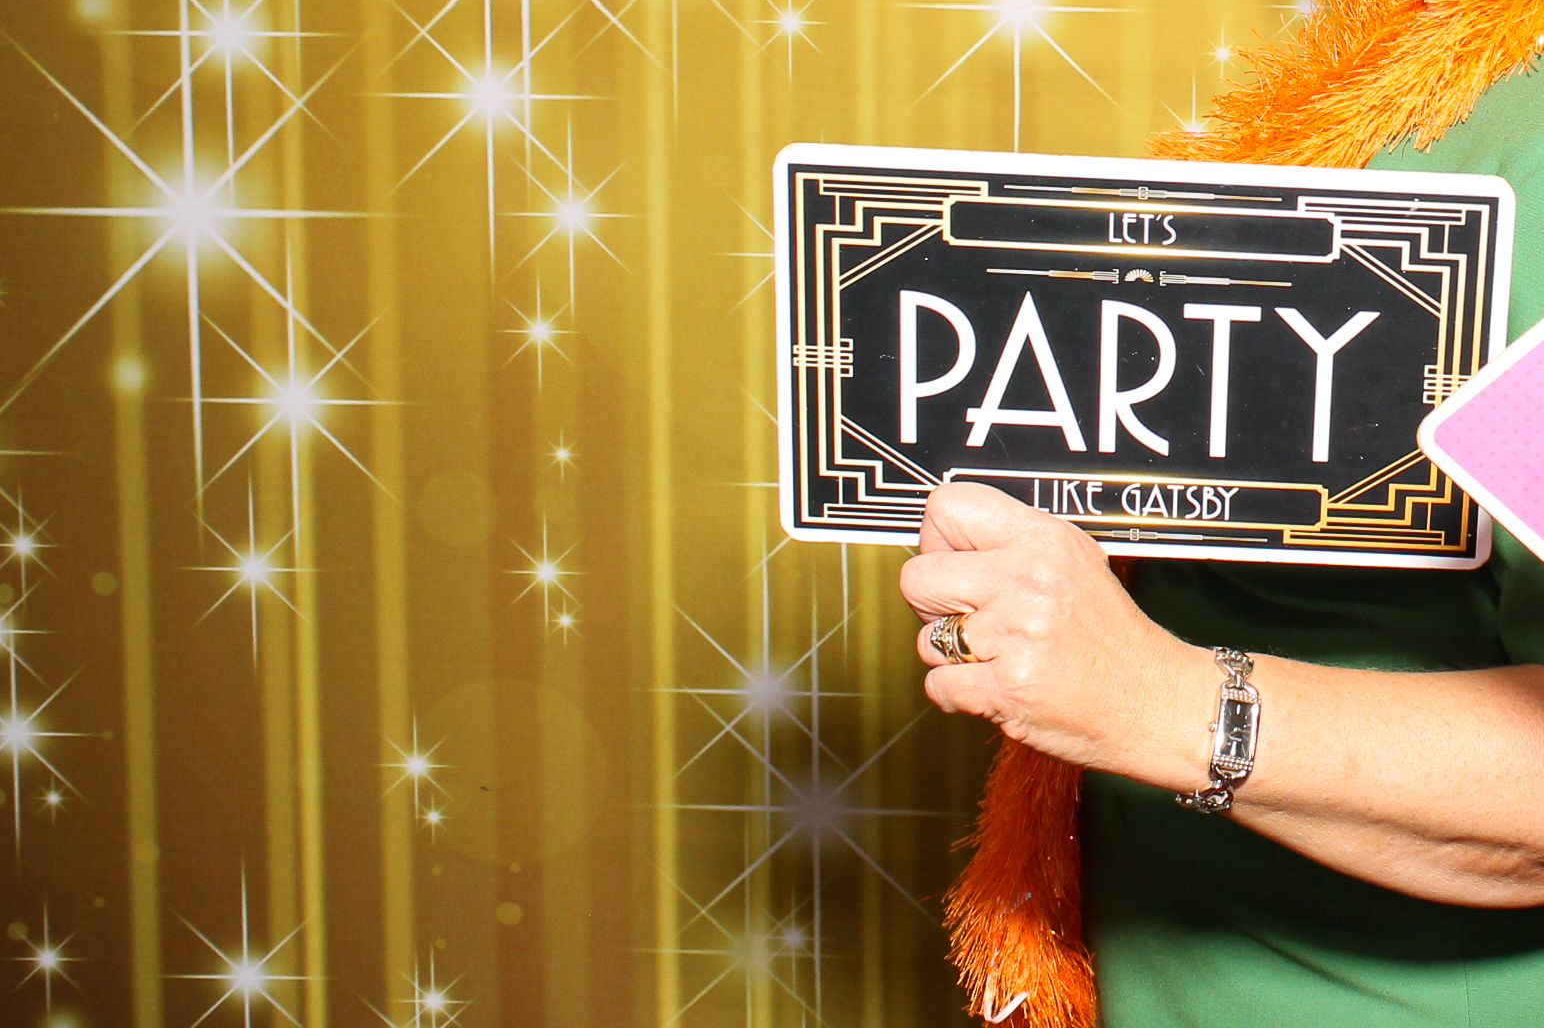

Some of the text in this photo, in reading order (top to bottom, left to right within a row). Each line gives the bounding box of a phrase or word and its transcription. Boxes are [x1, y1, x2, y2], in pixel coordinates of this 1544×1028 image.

[1108, 212, 1178, 246] LET'S
[899, 289, 1381, 463] PARTY
[1033, 478, 1240, 521] LIKE GATSBY
